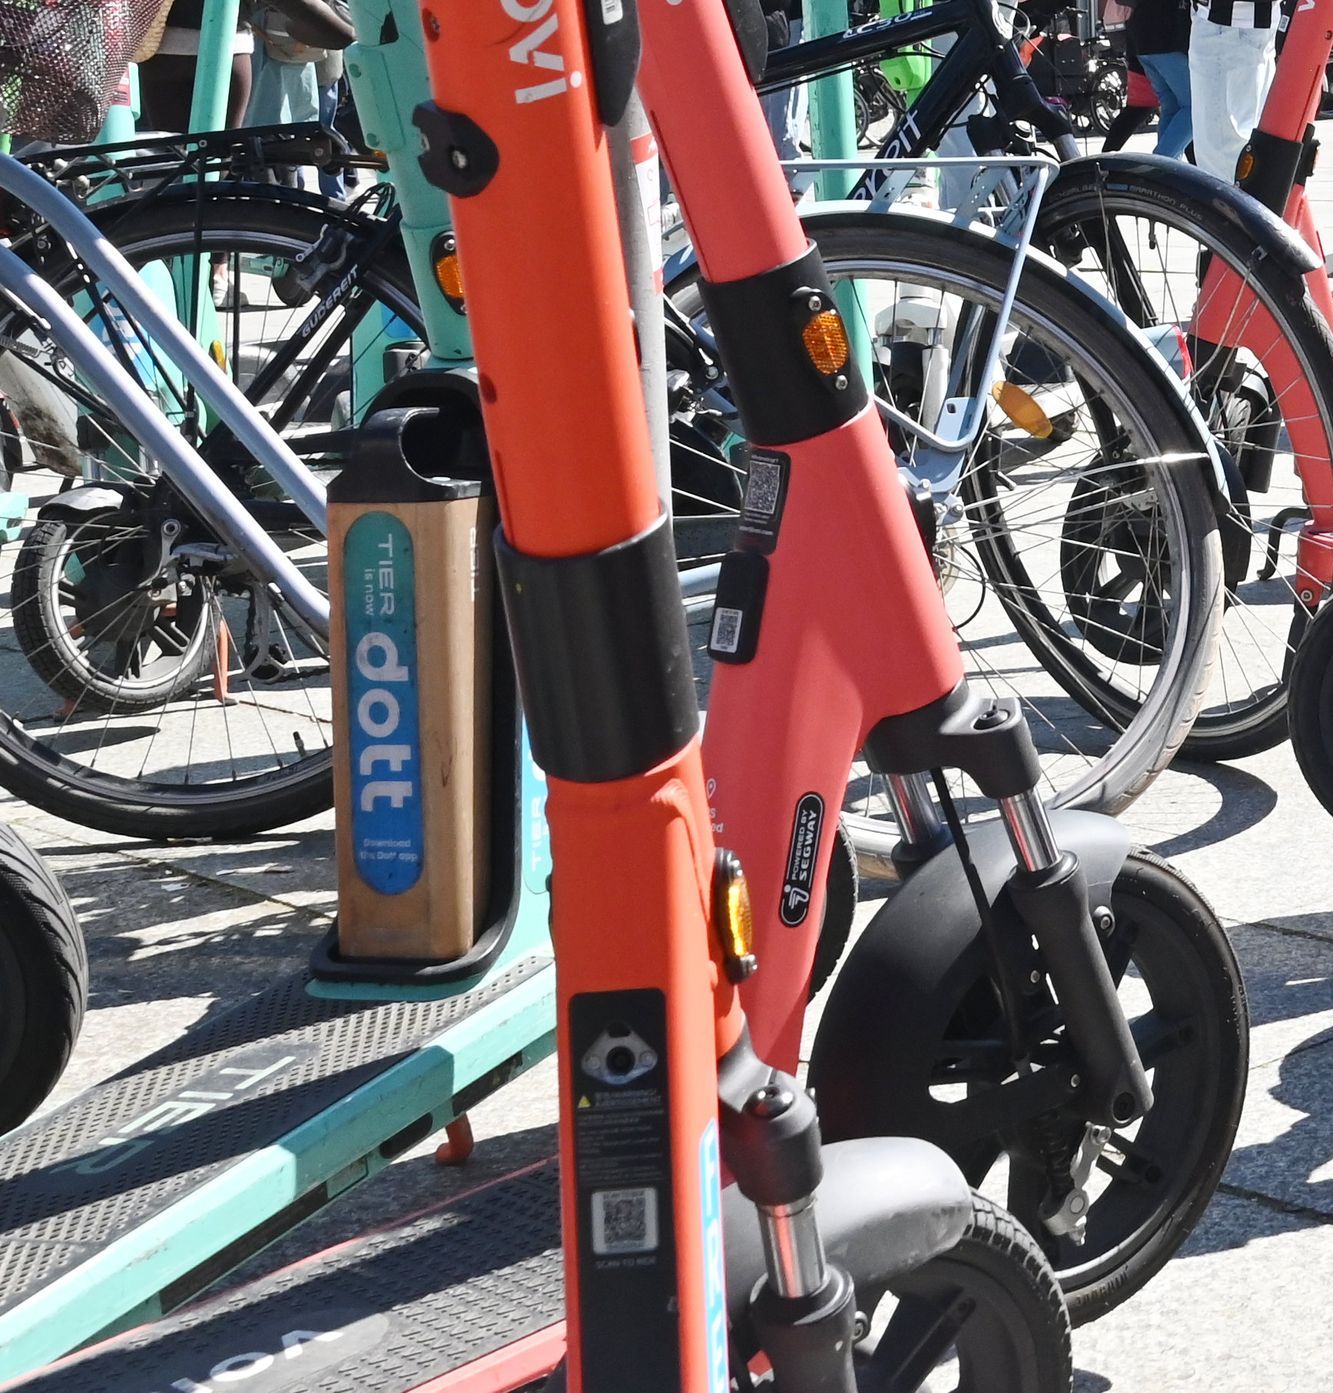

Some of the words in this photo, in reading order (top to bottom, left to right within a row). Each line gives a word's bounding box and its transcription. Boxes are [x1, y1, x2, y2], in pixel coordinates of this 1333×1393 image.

[364, 583, 375, 616] now
[377, 533, 395, 616] TIER
[355, 631, 413, 812] dott
[791, 826, 805, 881] POWERED
[800, 809, 808, 825] BY
[799, 810, 817, 882] SEGWAY
[48, 1054, 296, 1177] TIER
